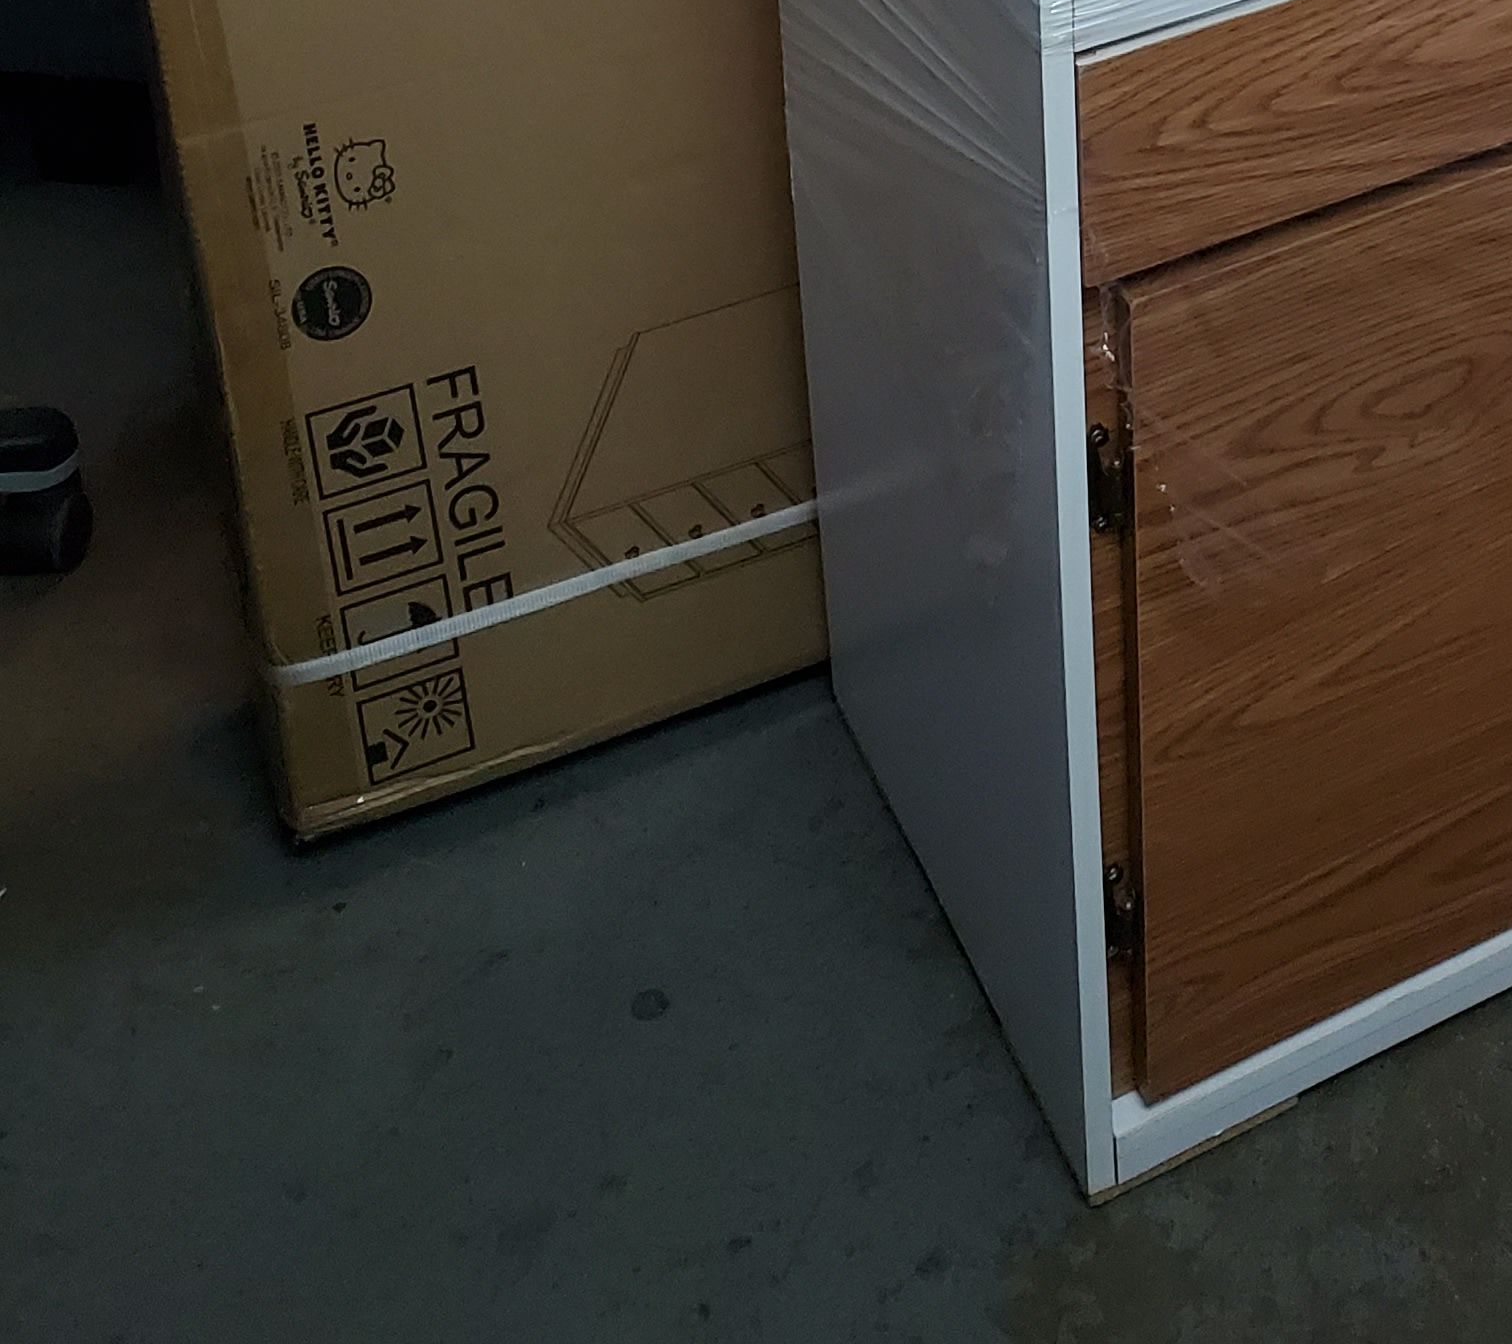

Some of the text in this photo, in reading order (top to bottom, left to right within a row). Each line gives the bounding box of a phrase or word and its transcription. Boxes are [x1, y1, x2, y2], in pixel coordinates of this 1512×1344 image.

[302, 122, 325, 179] HELLO
[426, 364, 514, 612] FRAGILE
[326, 675, 347, 697] RY
